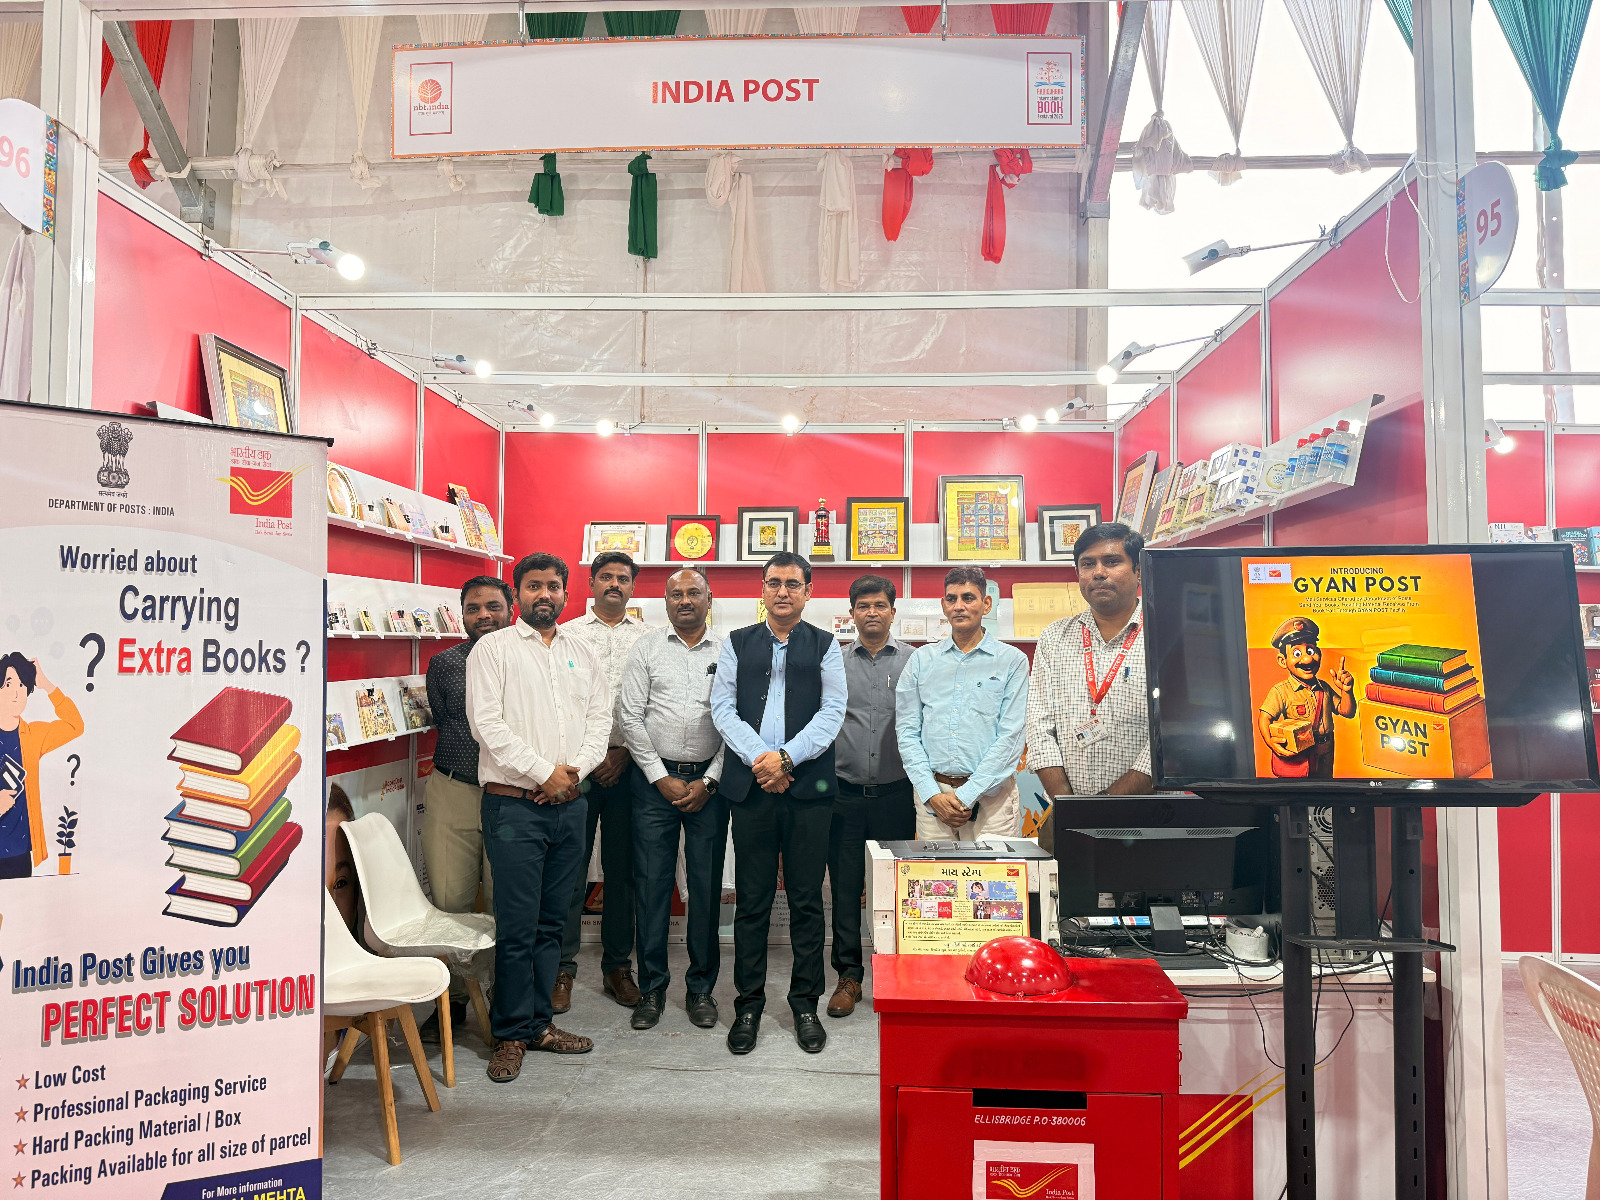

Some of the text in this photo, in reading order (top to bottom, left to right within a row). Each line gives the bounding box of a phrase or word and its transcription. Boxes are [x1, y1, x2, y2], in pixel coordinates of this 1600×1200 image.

[652, 79, 820, 104] INDIA POST
[1037, 101, 1064, 114] BOOK
[0, 136, 31, 179] 96
[1476, 198, 1502, 246] 95
[48, 498, 105, 512] DEPARTMENT
[106, 502, 118, 513] OF
[119, 503, 146, 515] POSTS
[152, 505, 175, 517] INDIA
[255, 518, 293, 530] India Post
[59, 545, 198, 574] Worried about
[1330, 567, 1384, 575] INTRODUCING
[1293, 575, 1422, 593] GYAN POST
[119, 584, 240, 632] Carrying
[117, 638, 311, 674] Extra Books ?
[1374, 715, 1428, 739] GYAN
[1380, 733, 1430, 757] POST
[941, 867, 959, 877] માય
[14, 945, 251, 989] India Post Gives you
[43, 974, 316, 1042] PERFECT SOLUTION
[34, 1064, 106, 1090] Low Cost
[33, 1074, 267, 1123] Professional Packaging Service
[32, 1109, 242, 1156] Hard Packing Material / Box
[974, 1114, 1087, 1127] ELLISBRIDGE P.O-380006
[30, 1126, 312, 1189] Packing Available for all size of parcel
[201, 1177, 284, 1200] For More information
[1045, 1188, 1061, 1196] India
